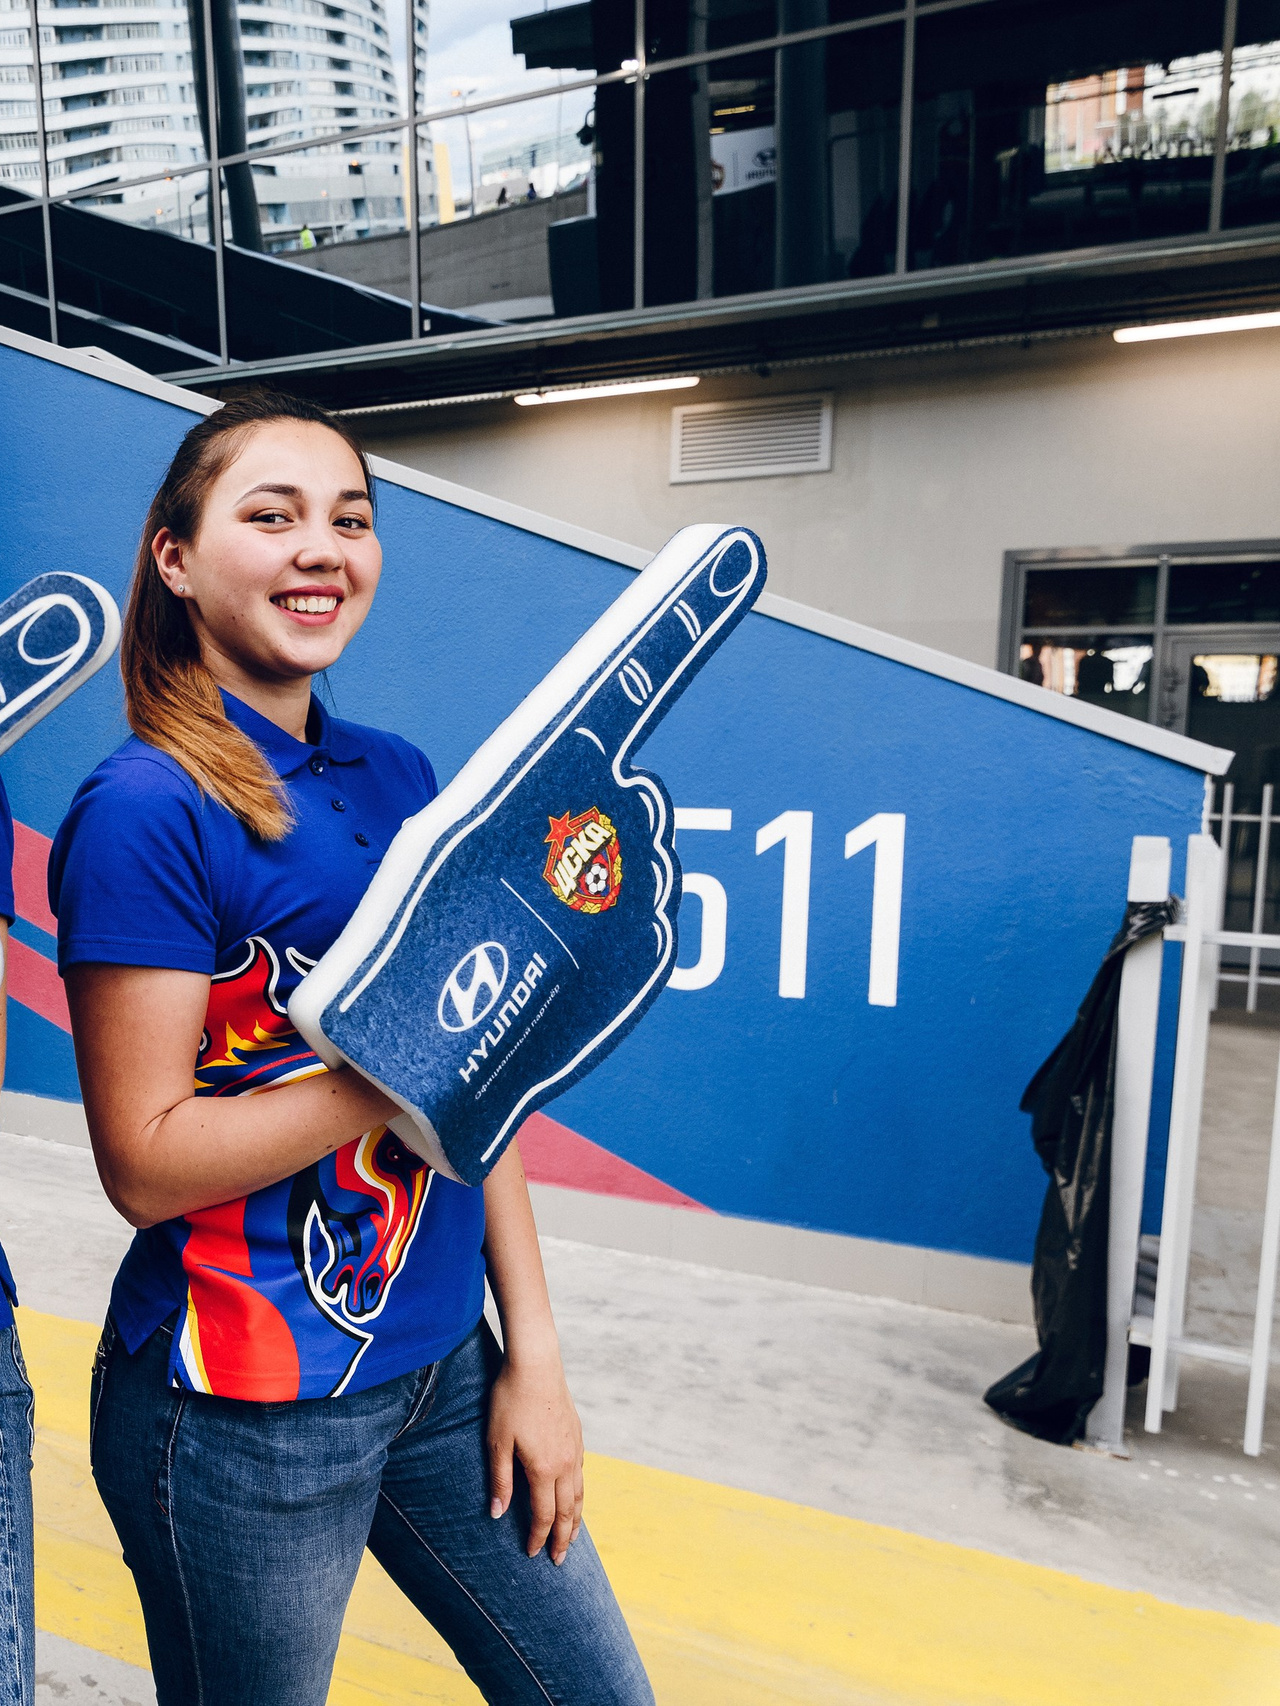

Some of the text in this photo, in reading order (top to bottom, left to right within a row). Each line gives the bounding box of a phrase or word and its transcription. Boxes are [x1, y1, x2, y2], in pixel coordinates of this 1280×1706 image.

[553, 820, 613, 899] ЦСКА
[665, 807, 906, 1007] 511
[458, 951, 549, 1084] HYUNDAI
[474, 1026, 532, 1101] Официальный
